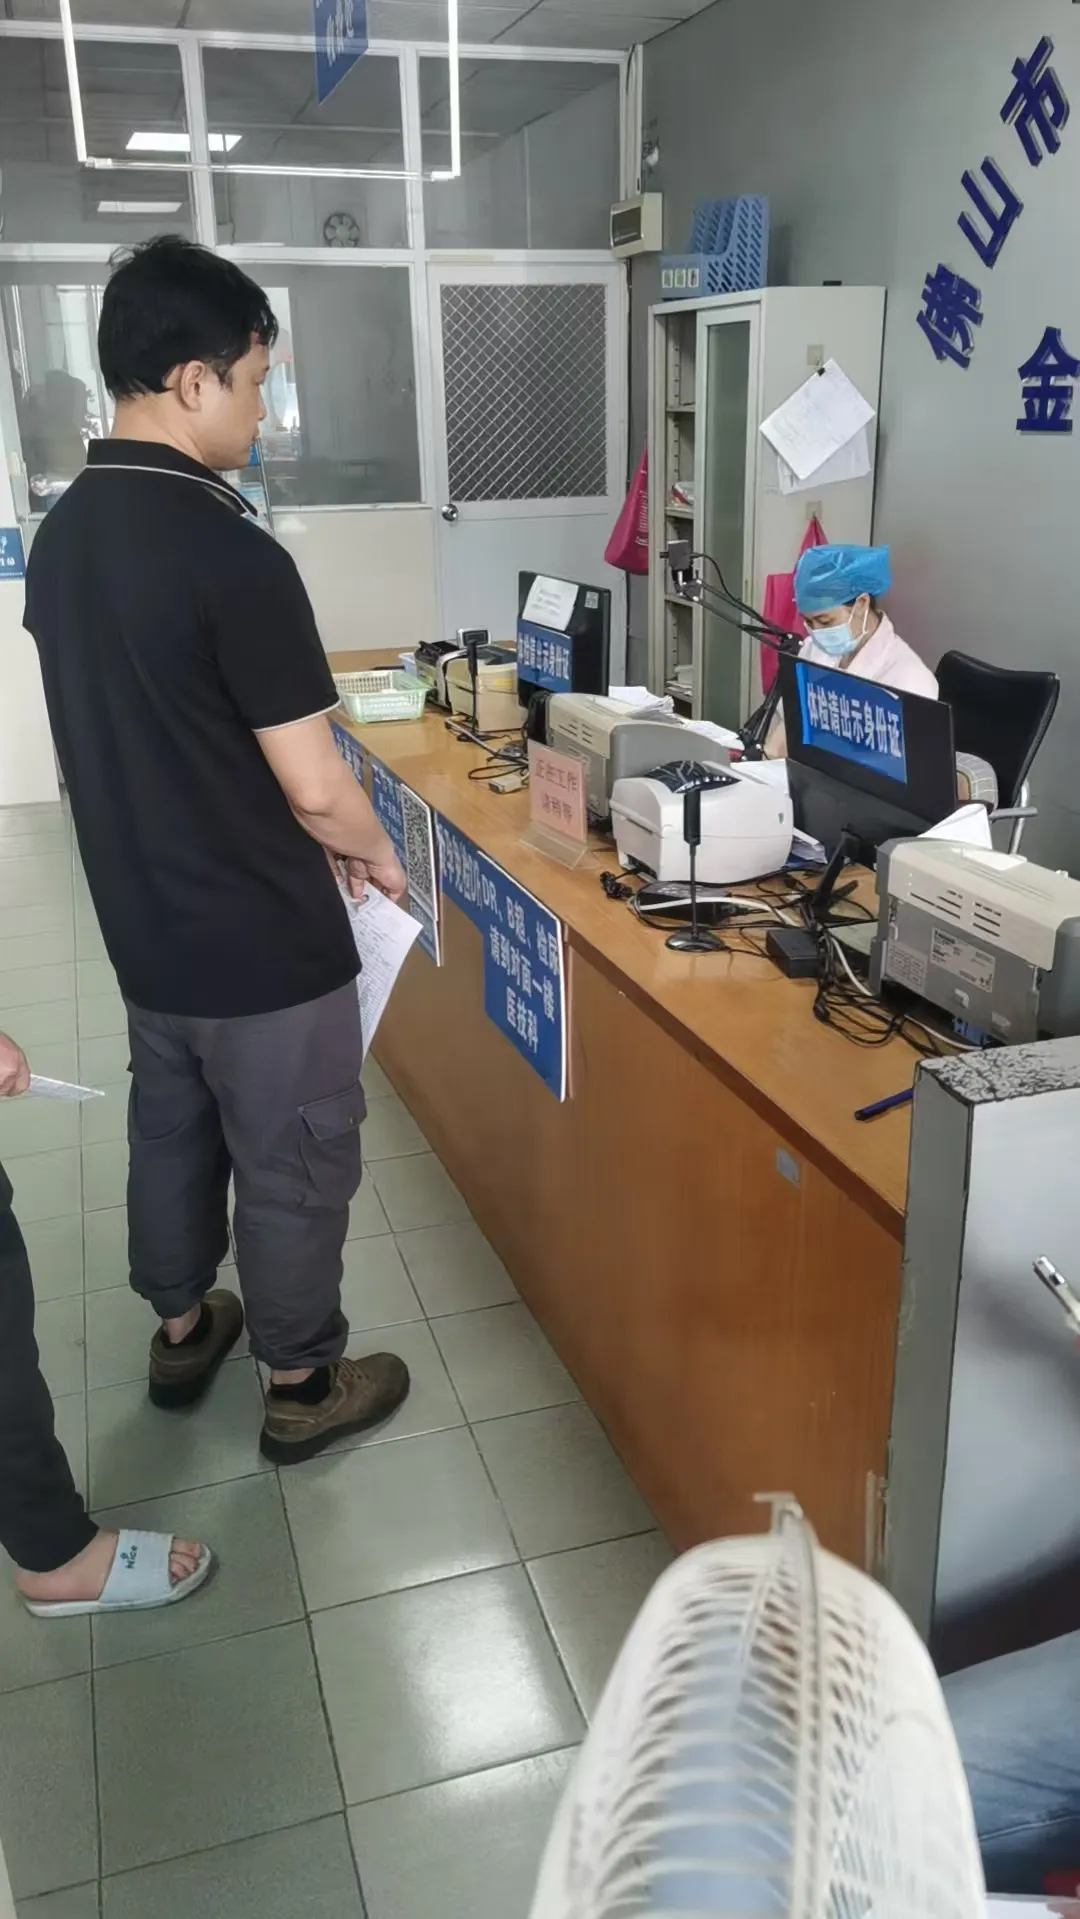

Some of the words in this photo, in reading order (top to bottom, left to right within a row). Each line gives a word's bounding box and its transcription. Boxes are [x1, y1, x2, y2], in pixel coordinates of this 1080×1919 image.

[916, 35, 1070, 369] 佛山市
[1016, 326, 1080, 433] 金
[806, 682, 902, 758] 体检请出示身份证
[535, 759, 578, 792] 正在工作
[490, 924, 555, 1023] 请到对面一楼
[506, 986, 538, 1053] 医技科
